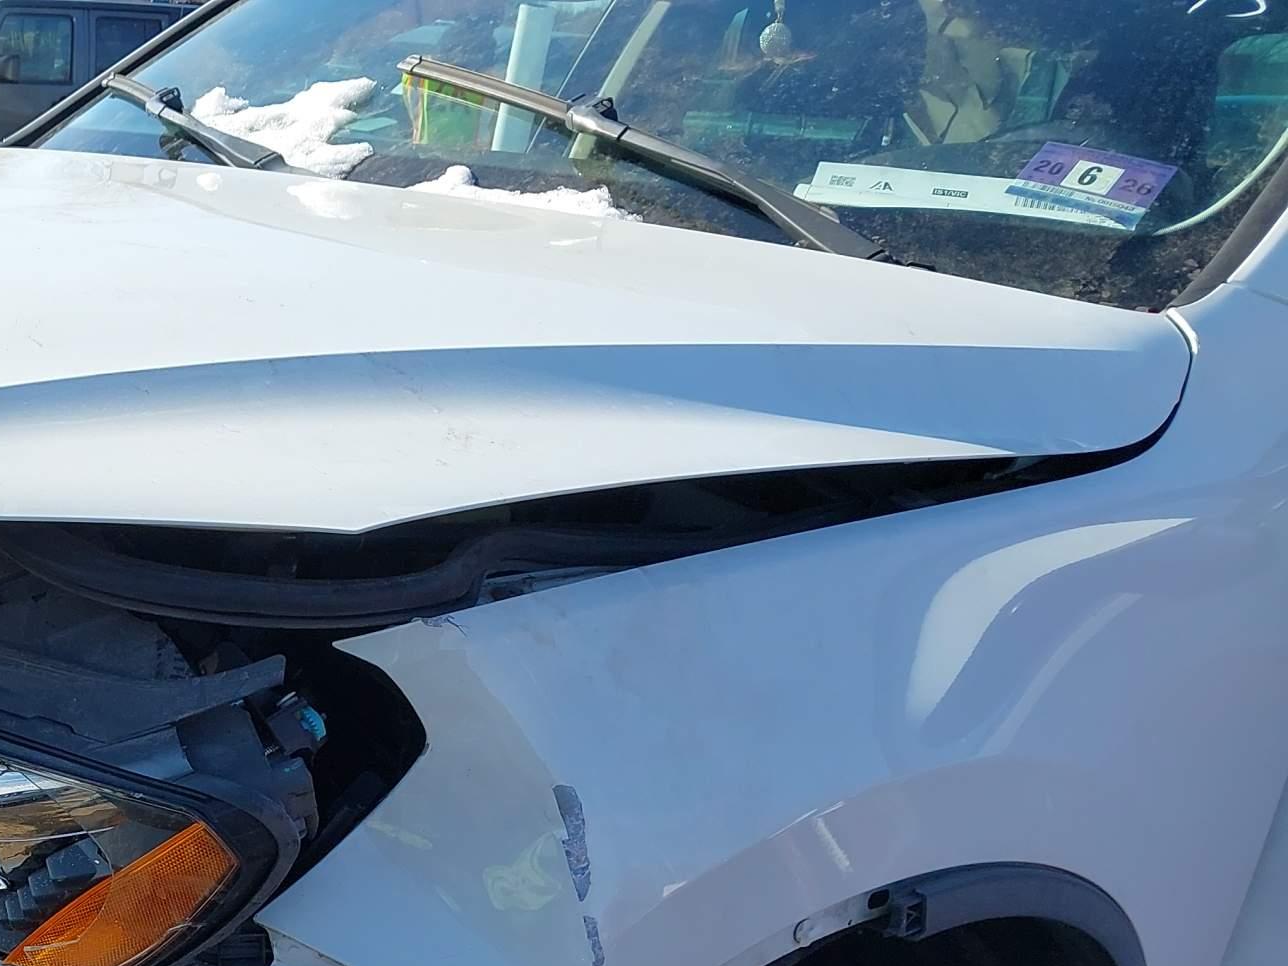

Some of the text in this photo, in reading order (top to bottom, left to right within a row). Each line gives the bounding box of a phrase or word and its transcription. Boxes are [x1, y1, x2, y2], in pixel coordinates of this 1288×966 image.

[1032, 159, 1065, 176] 20
[1077, 166, 1104, 187] 6
[1118, 178, 1153, 197] 26
